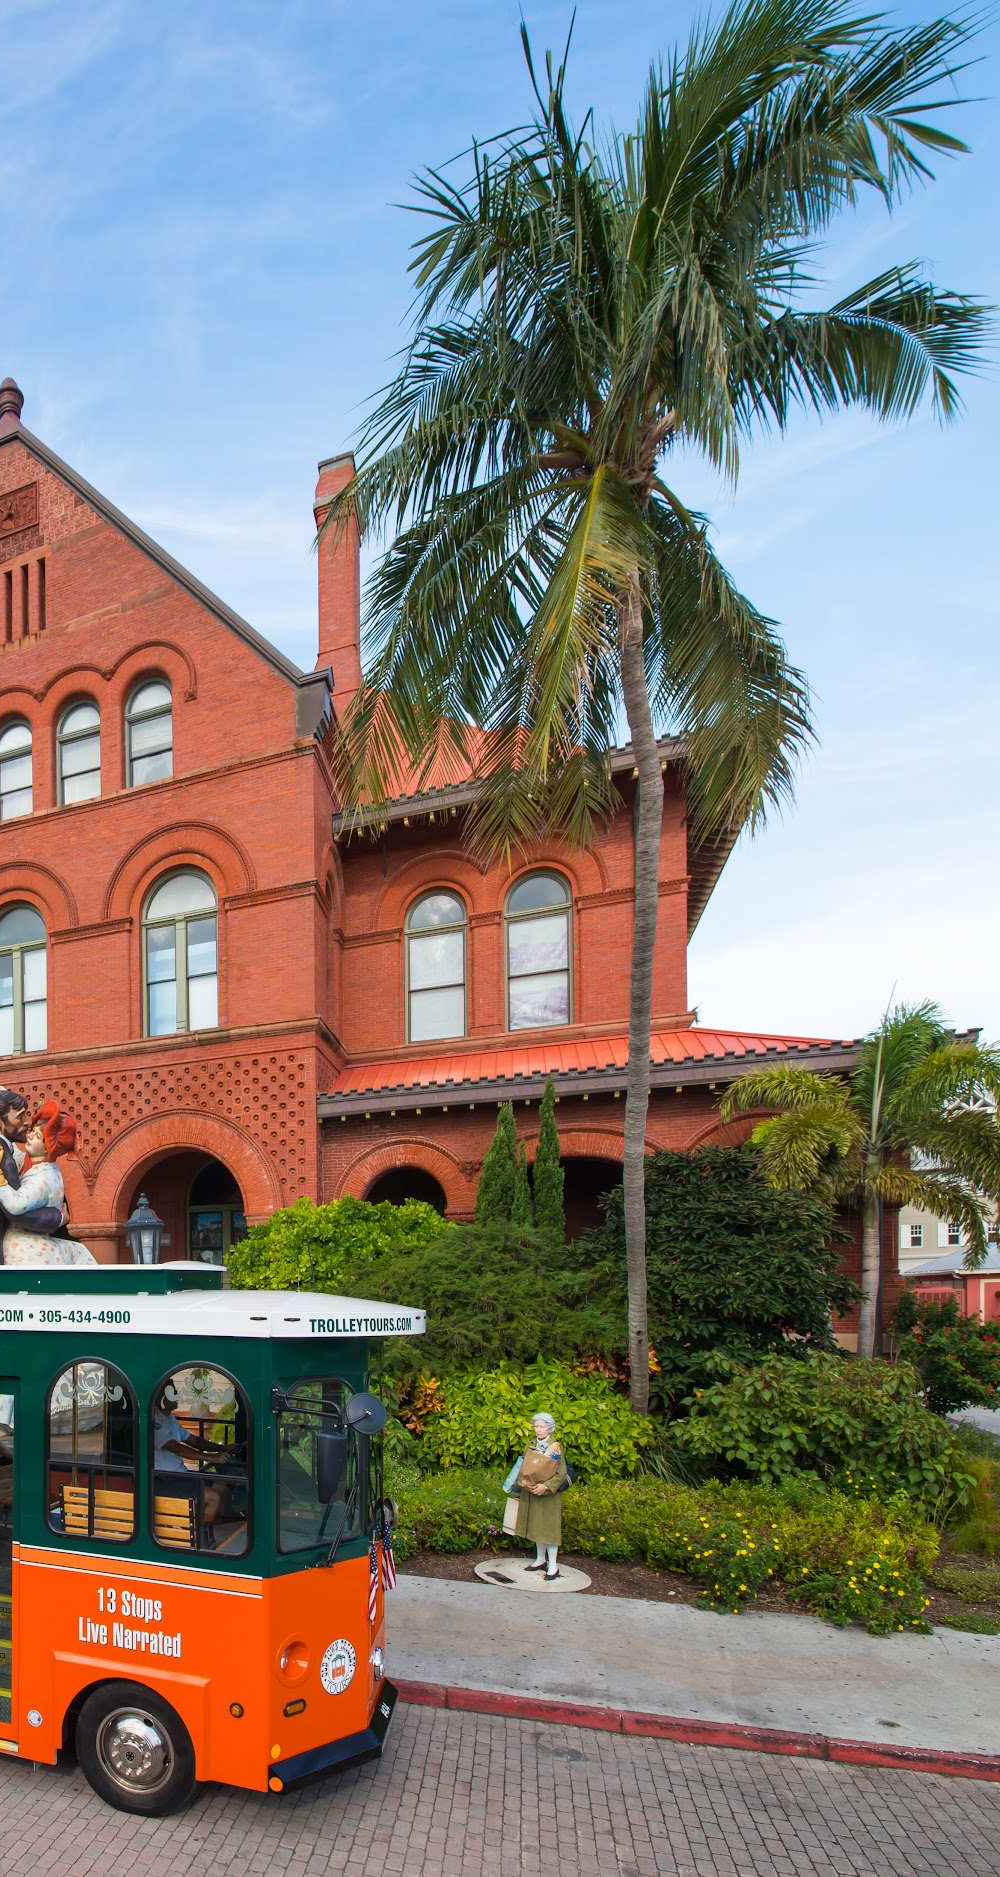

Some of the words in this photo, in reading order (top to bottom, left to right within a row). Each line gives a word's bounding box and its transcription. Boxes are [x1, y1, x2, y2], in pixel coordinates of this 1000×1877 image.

[39, 1310, 131, 1324] 305-434-4900
[309, 1317, 412, 1333] TROLLEYTOURS.COM
[97, 1587, 117, 1614] 13
[121, 1590, 163, 1624] Stops
[78, 1616, 108, 1646] Live
[112, 1622, 182, 1659] Narrated
[324, 1641, 339, 1660] TOWN
[340, 1639, 356, 1667] TROLLEY
[326, 1675, 352, 1694] TOURS
